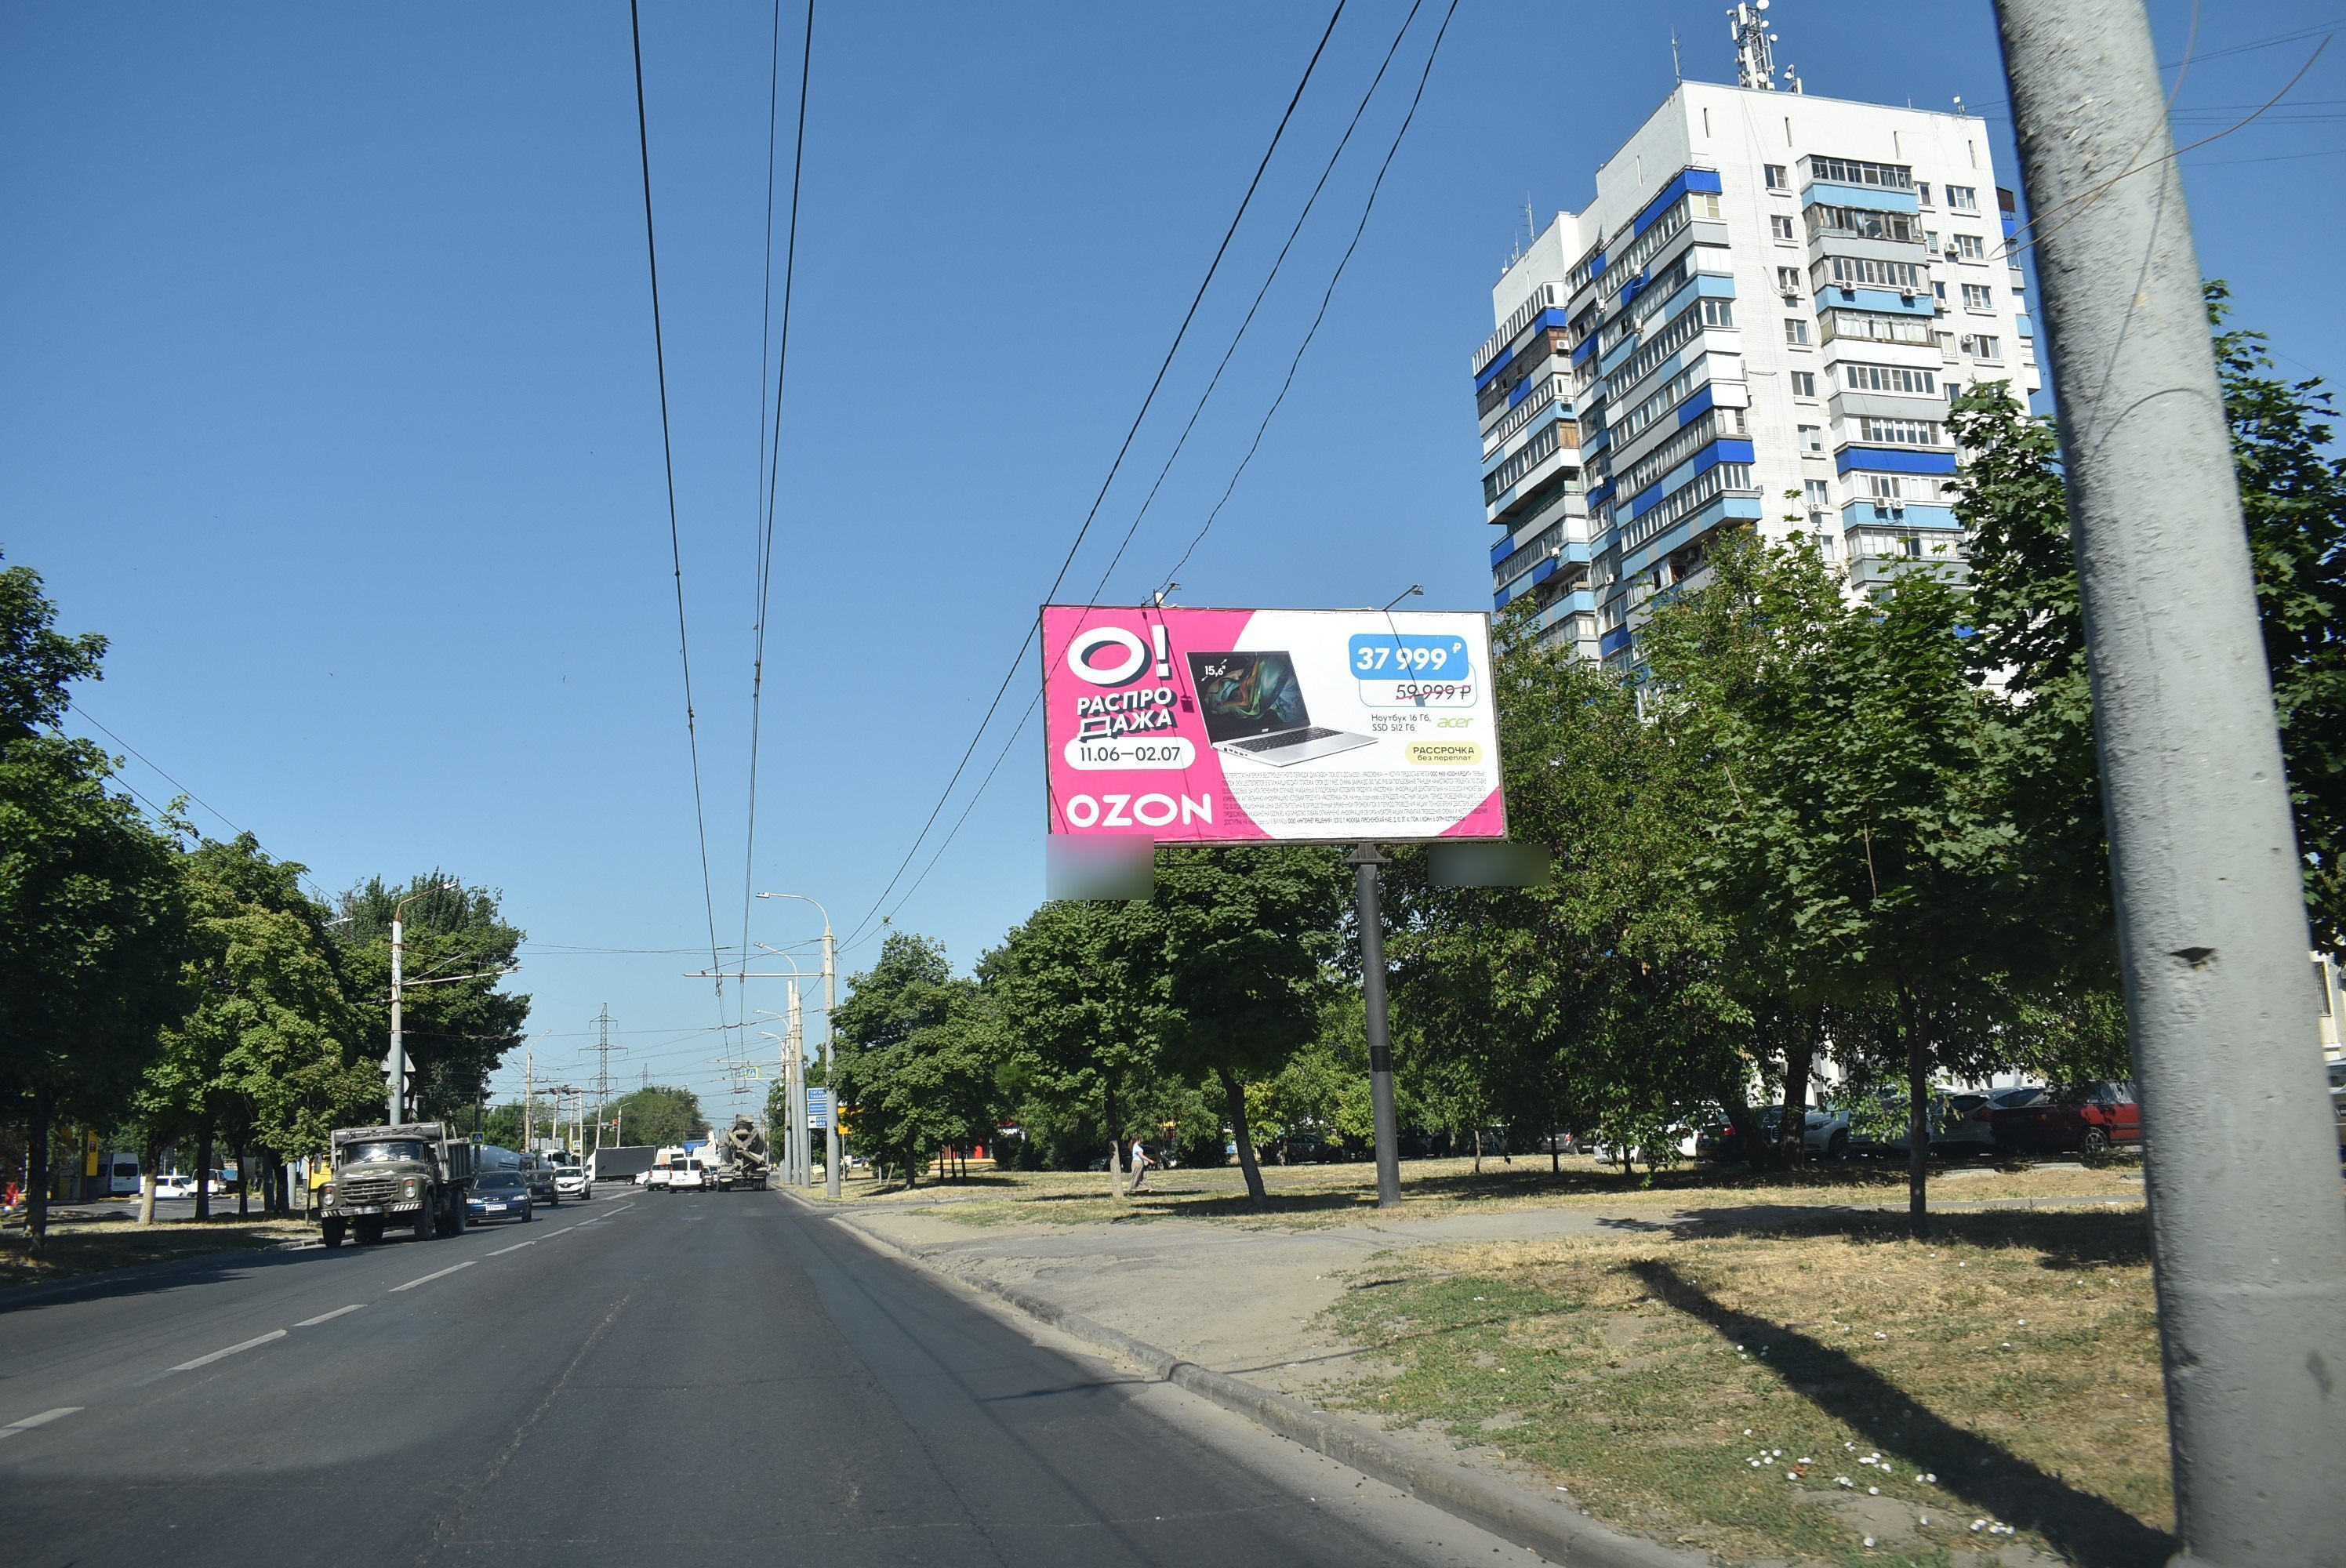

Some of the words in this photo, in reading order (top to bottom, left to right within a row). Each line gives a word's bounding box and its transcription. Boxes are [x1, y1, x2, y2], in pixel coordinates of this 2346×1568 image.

[1356, 648, 1390, 670] 37
[1396, 648, 1447, 670] 999
[1077, 687, 1178, 717] РАСПРО
[1396, 684, 1418, 700] 59
[1423, 684, 1455, 700] 999
[1077, 709, 1178, 743] ДАЖА
[1371, 714, 1407, 723] Ноутбук
[1420, 714, 1432, 723] Гб,
[1437, 717, 1474, 728] acer
[1066, 793, 1213, 827] OZON
